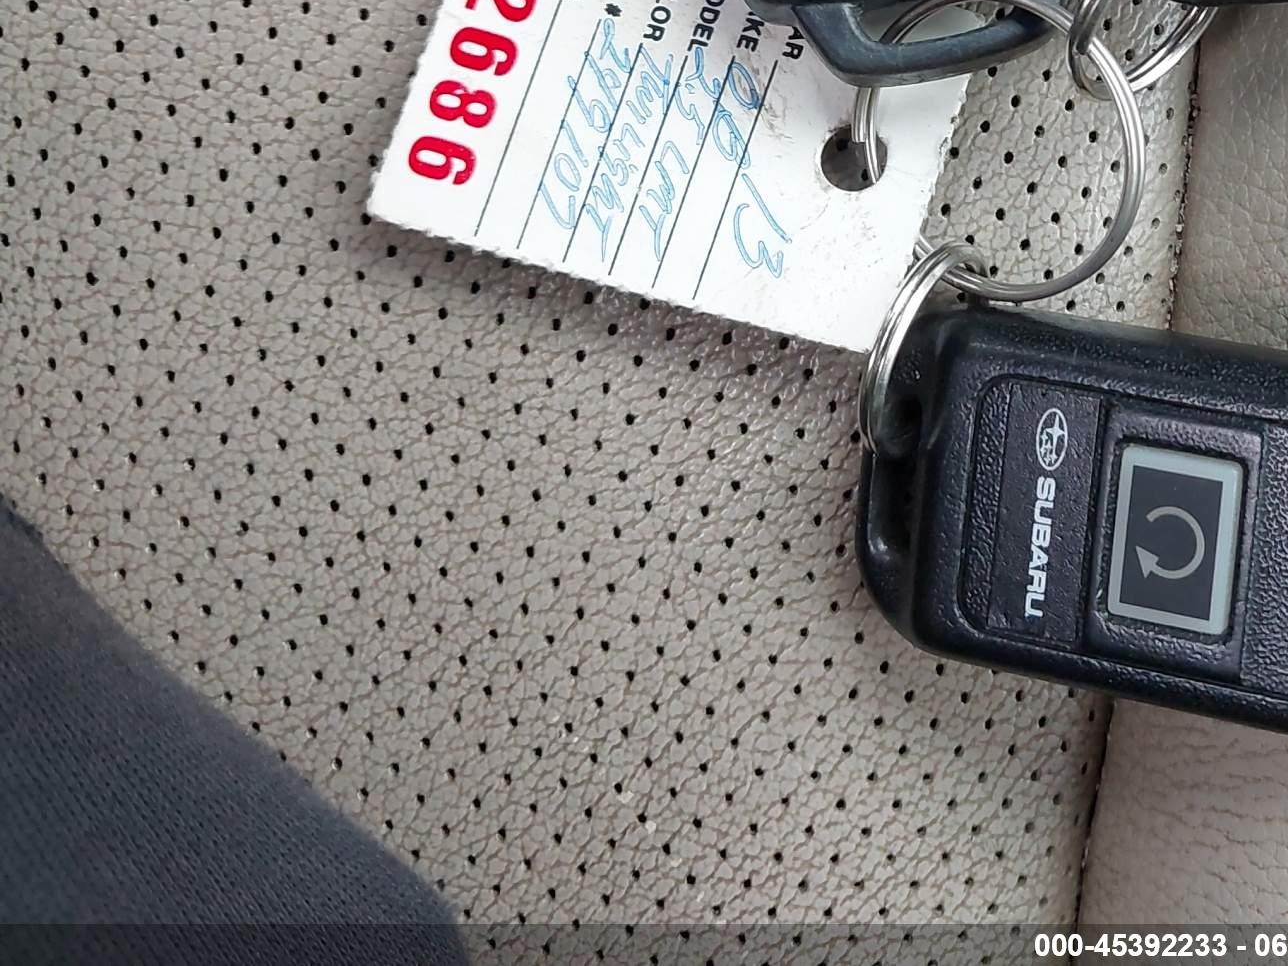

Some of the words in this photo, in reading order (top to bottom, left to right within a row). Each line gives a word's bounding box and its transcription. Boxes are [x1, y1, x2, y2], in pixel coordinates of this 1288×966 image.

[604, 2, 623, 17] #
[736, 11, 765, 52] KE
[781, 25, 806, 60] AR
[733, 172, 794, 279] 13
[1024, 475, 1057, 619] SUBARU
